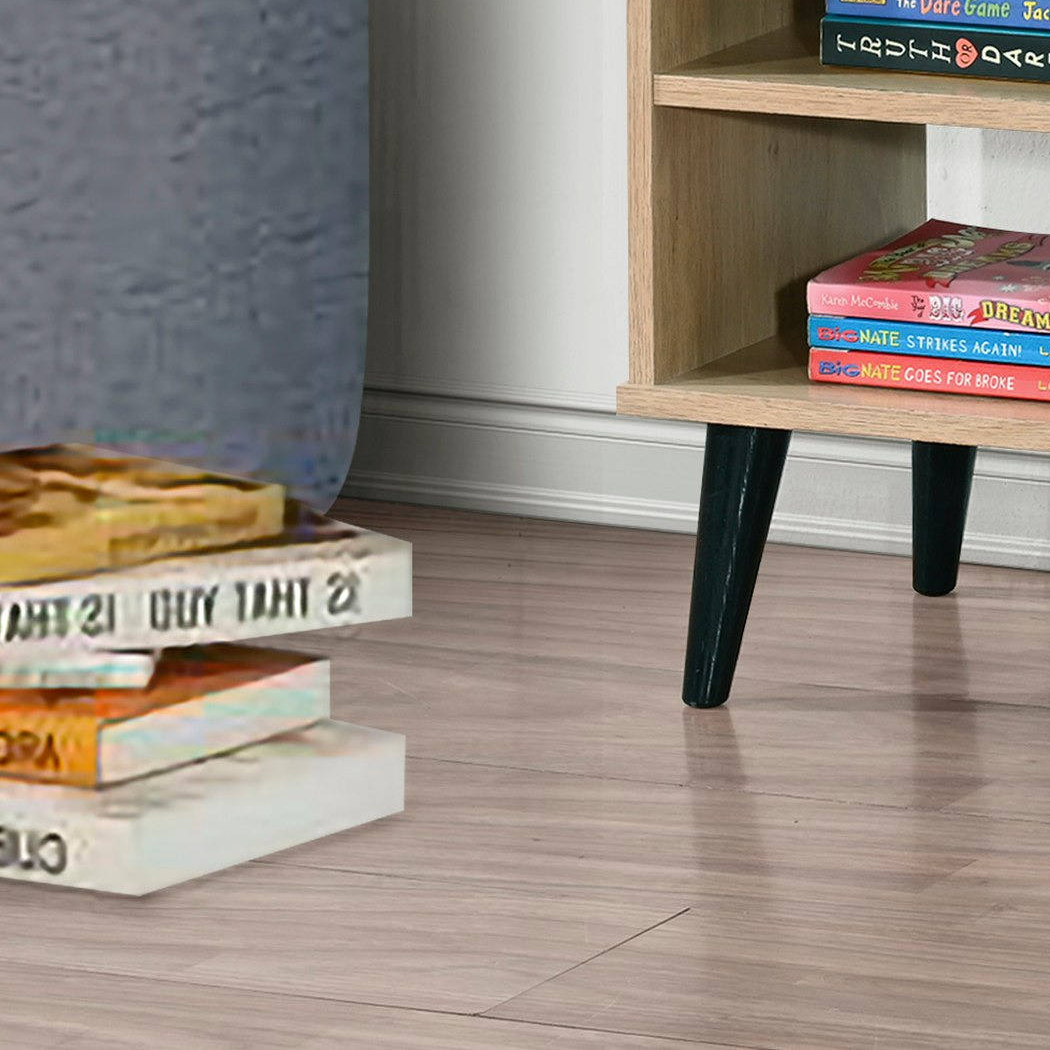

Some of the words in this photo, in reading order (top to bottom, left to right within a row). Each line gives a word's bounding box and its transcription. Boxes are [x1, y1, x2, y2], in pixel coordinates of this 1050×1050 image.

[836, 34, 952, 64] TRUTH
[821, 294, 849, 306] Karen
[850, 295, 899, 310] McCombie
[859, 329, 900, 347] NATE
[906, 334, 968, 352] STRIKES
[973, 340, 1022, 358] AGAIN!
[861, 363, 902, 381] NATE
[904, 367, 942, 384] GOES
[946, 371, 971, 387] FOR
[975, 374, 1015, 390] BROKE
